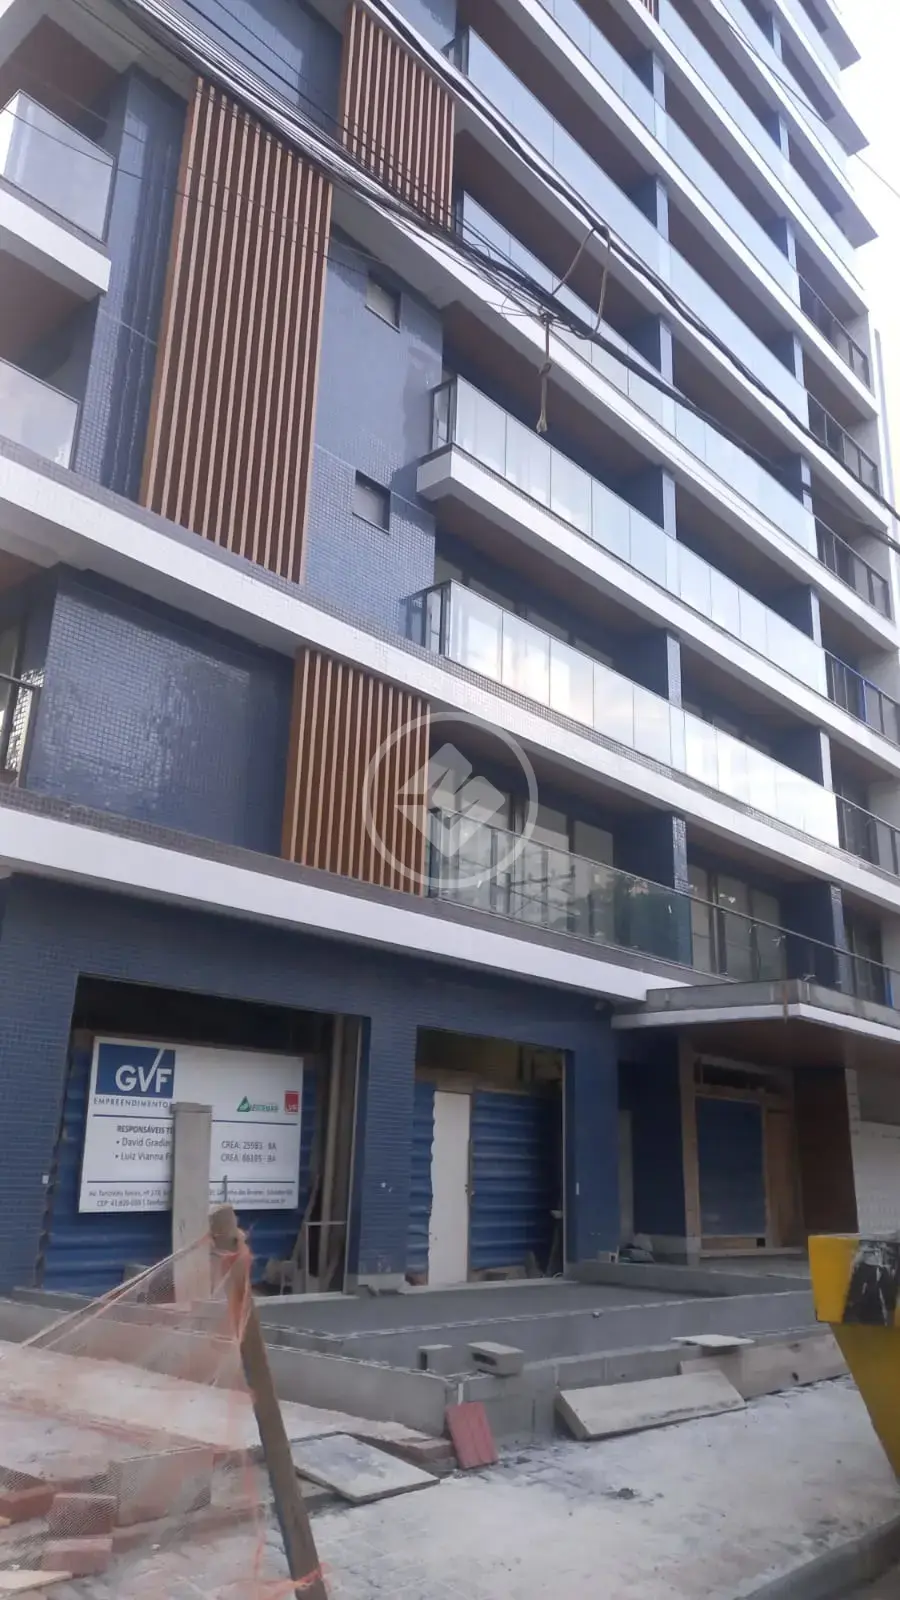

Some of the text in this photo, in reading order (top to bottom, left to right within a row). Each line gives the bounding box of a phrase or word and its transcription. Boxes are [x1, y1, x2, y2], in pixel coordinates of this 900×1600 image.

[115, 1049, 172, 1093] GVF
[93, 1097, 171, 1109] EMPREENDIMENTO
[121, 1137, 144, 1147] David
[120, 1152, 136, 1161] Luiz
